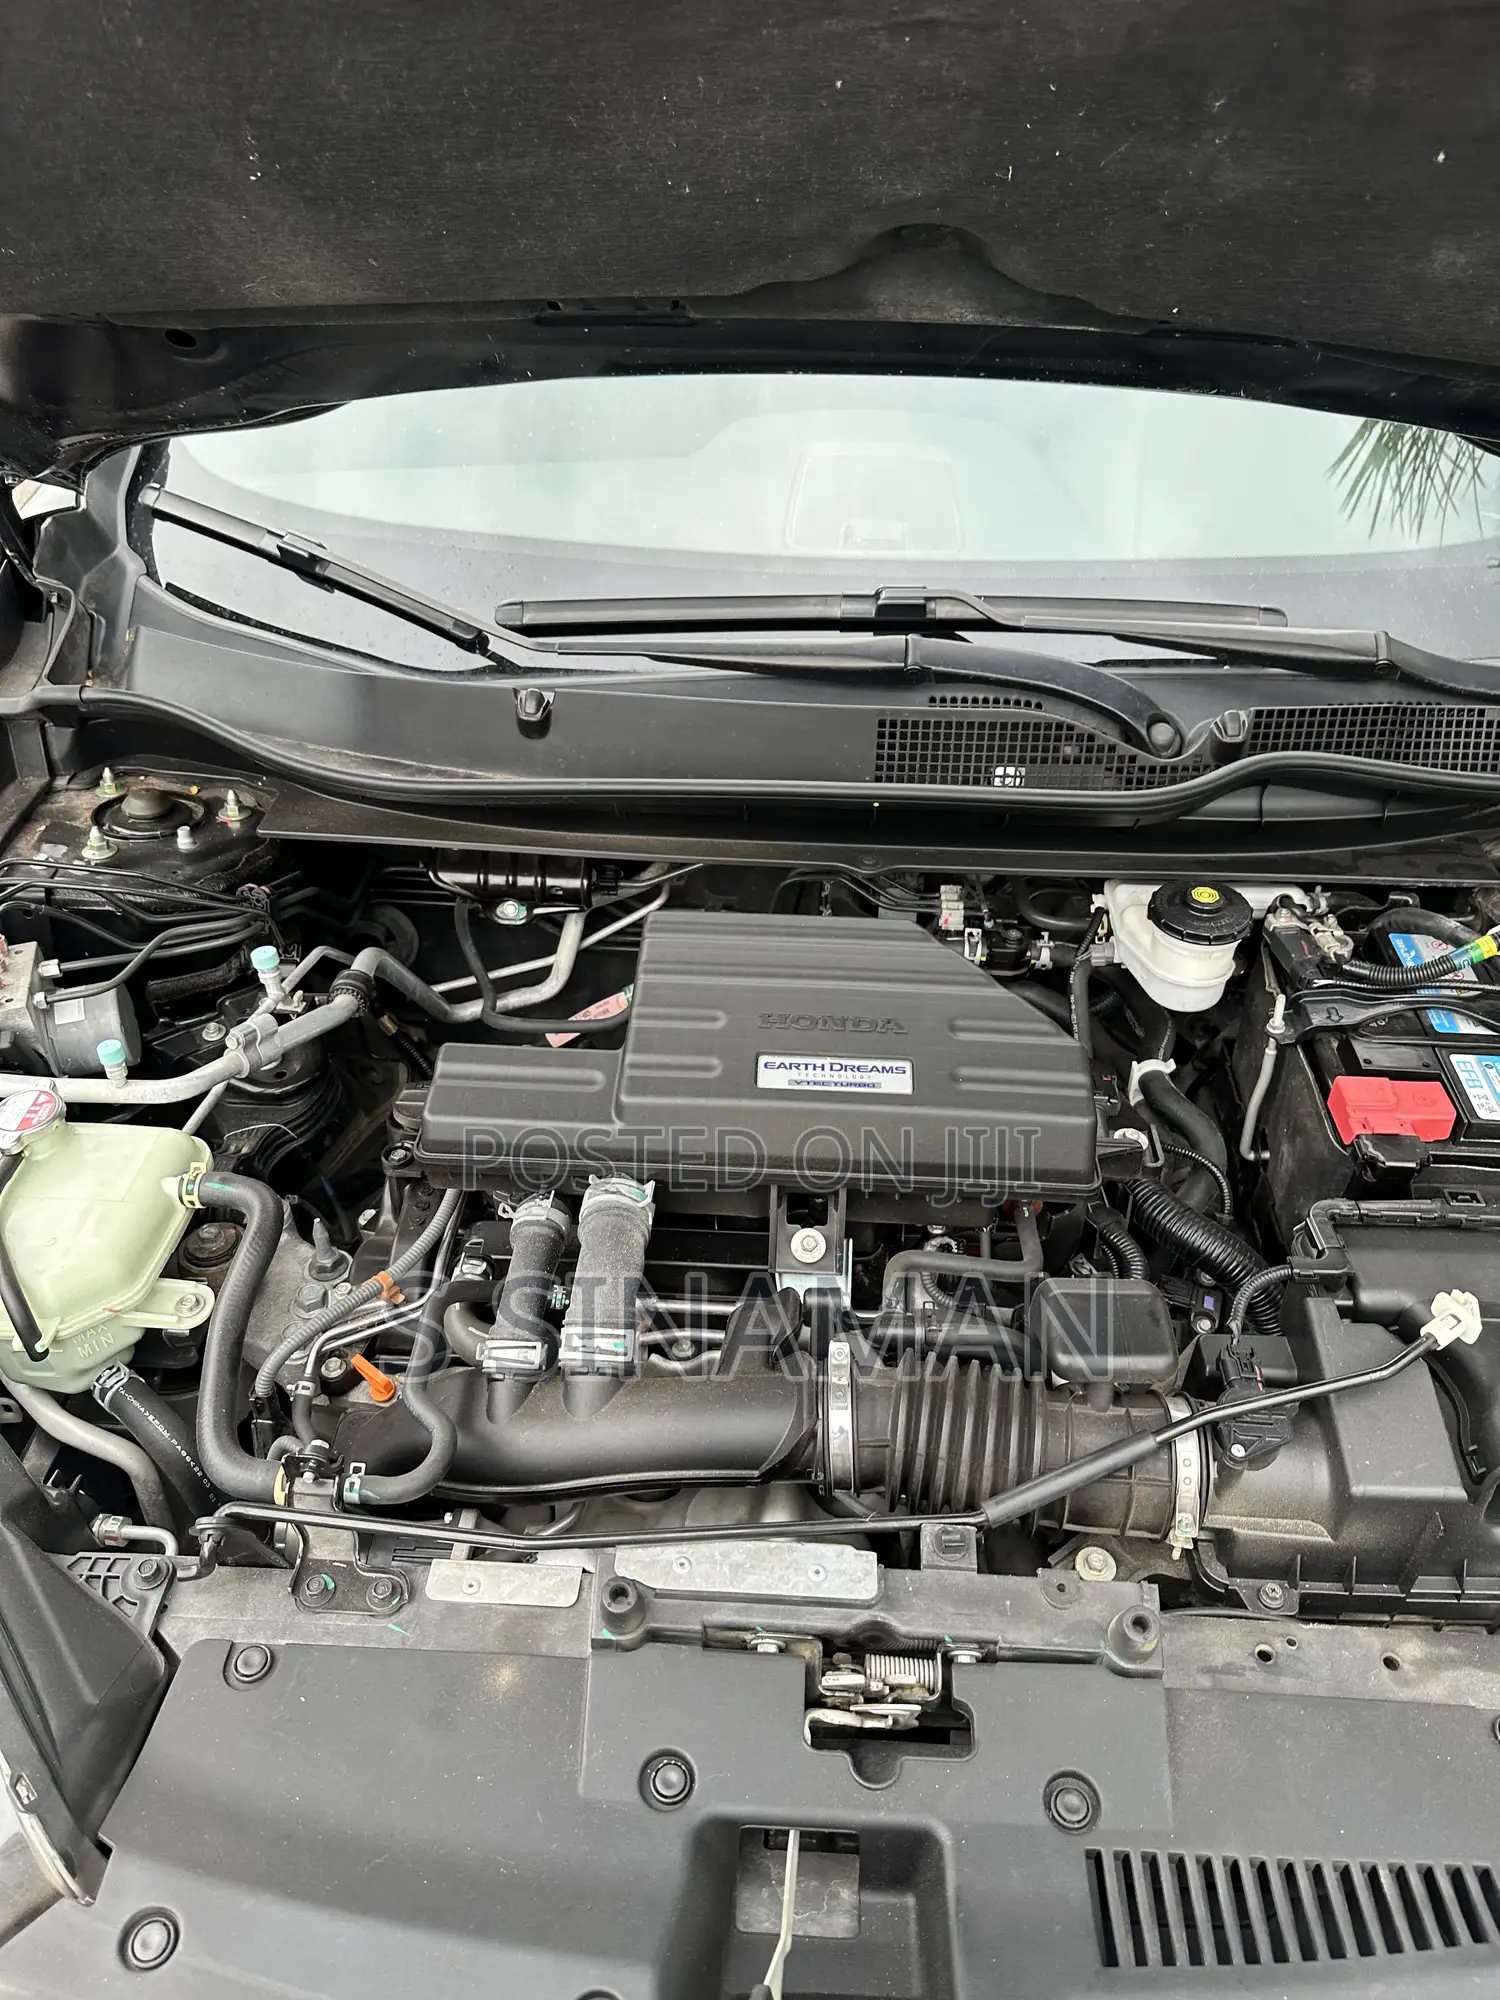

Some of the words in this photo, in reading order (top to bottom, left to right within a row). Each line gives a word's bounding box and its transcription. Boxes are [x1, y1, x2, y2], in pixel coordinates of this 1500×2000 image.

[758, 1013, 908, 1034] HONDA
[764, 1061, 825, 1072] EARTH
[829, 1062, 907, 1075] DREAMS
[78, 1333, 115, 1358] MIN
